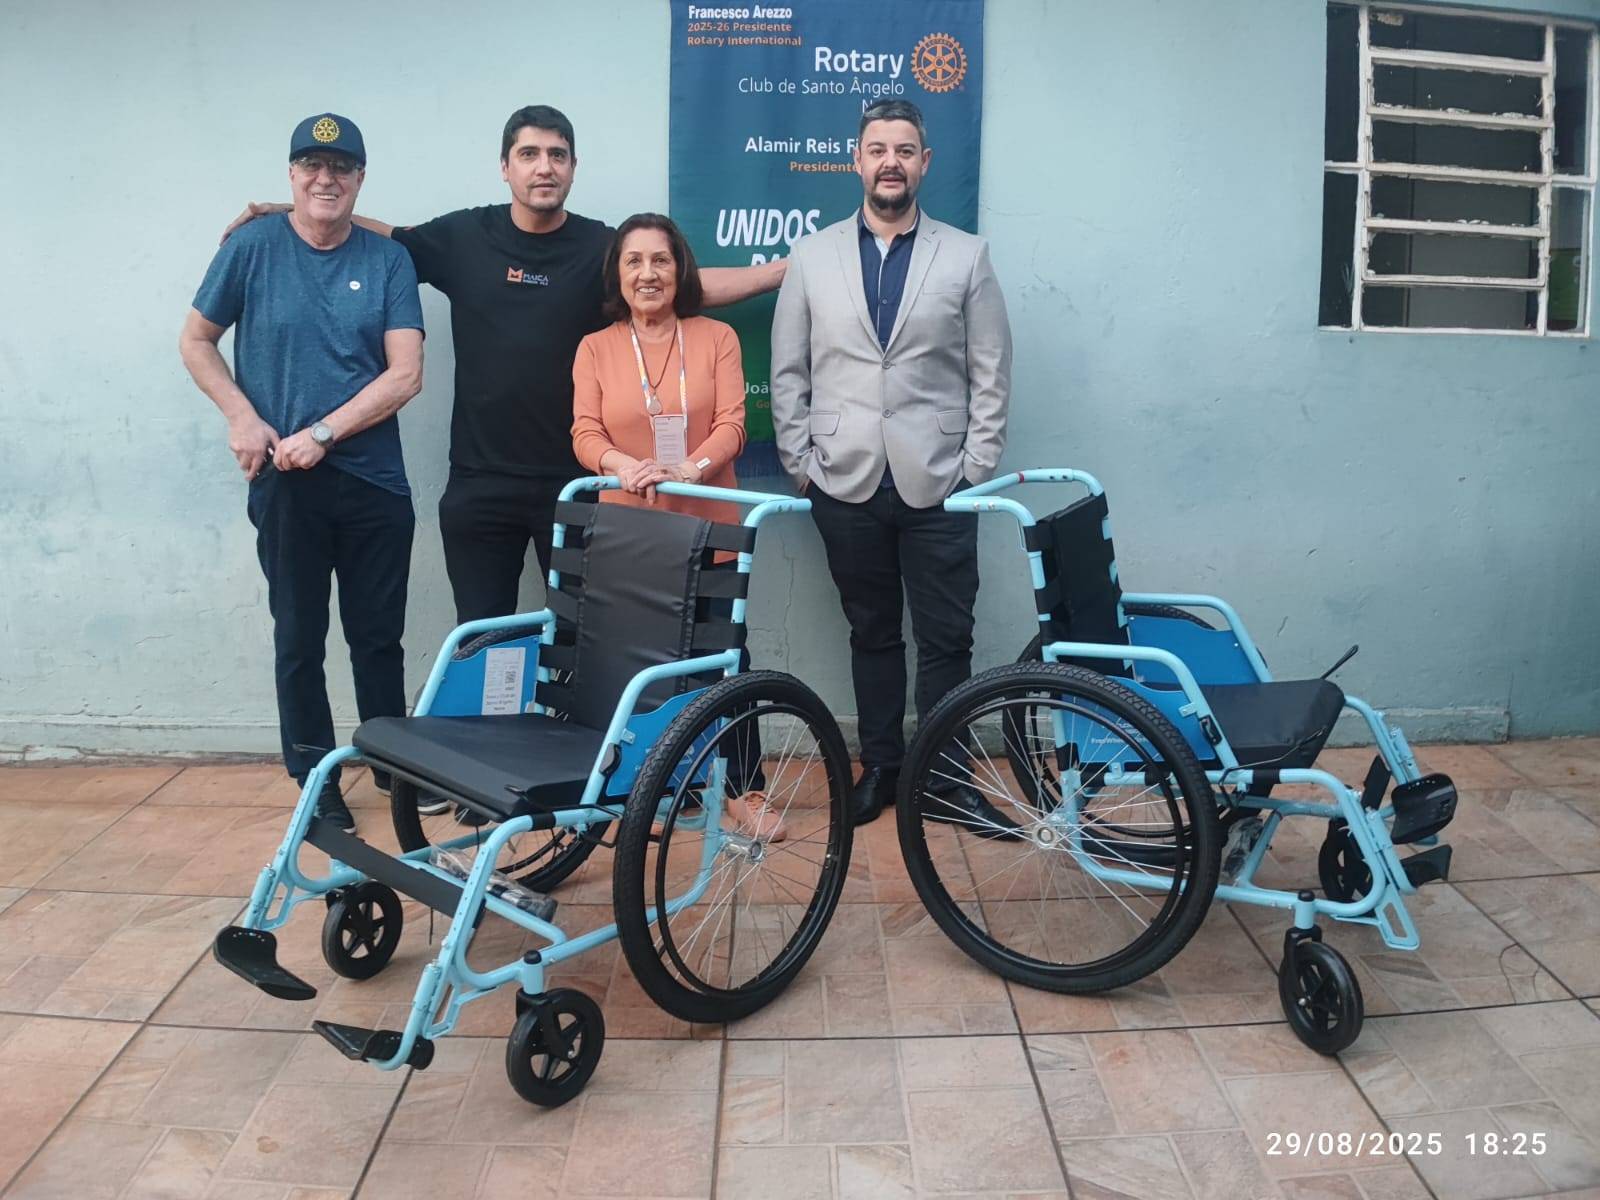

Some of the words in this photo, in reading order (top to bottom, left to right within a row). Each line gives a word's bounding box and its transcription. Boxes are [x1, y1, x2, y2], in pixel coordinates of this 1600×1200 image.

[688, 5, 750, 19] Francesco
[752, 4, 793, 19] Arezzo
[687, 22, 730, 32] 2025-26
[733, 22, 793, 32] Presidente
[687, 36, 725, 47] Rotary
[727, 36, 802, 46] International
[814, 46, 904, 79] Rotary
[738, 77, 773, 94] Club
[778, 78, 796, 94] de
[801, 79, 845, 95] Santo
[850, 76, 904, 98] Ângelo
[744, 135, 802, 153] Alamir
[806, 137, 841, 154] Reis
[716, 209, 821, 247] UNIDOS
[745, 381, 770, 394] Joã
